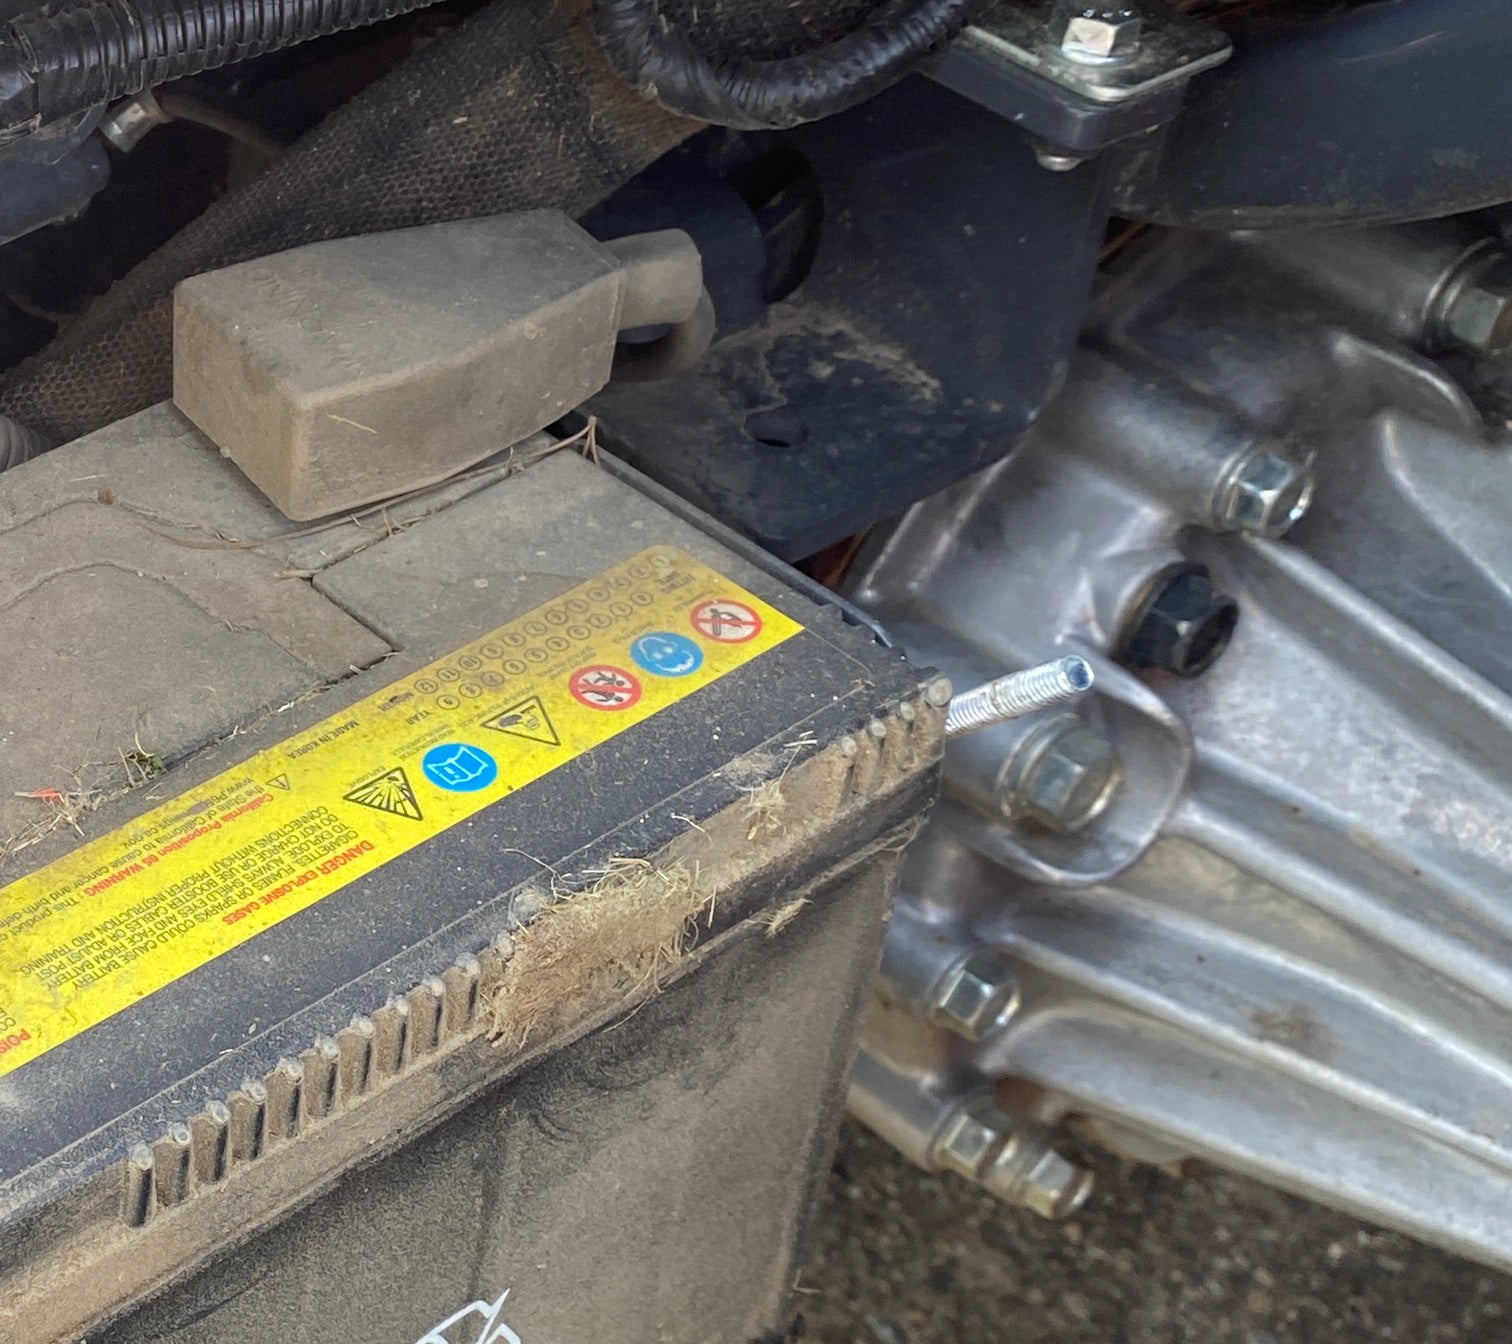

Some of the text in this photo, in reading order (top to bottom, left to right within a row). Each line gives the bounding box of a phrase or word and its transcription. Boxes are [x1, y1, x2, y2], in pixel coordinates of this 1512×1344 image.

[404, 708, 432, 725] YEAR
[286, 719, 359, 760] MADE IN KOREA
[214, 793, 247, 813] State
[242, 784, 265, 798] the
[202, 808, 219, 819] of
[219, 791, 275, 824] California
[153, 815, 207, 846] California
[154, 818, 223, 858] Proposition
[253, 804, 329, 849] CONNECTIONS
[329, 821, 349, 834] TO
[109, 847, 143, 868] cause
[141, 841, 157, 852] to
[206, 843, 257, 874] WITHOUT
[140, 853, 160, 867] 65
[241, 855, 286, 882] ALWAYS
[69, 864, 110, 888] cancer
[82, 861, 144, 897] WARNING
[163, 868, 211, 897] PROPER
[220, 839, 374, 925] DANGER EXPLOSIVE GASES
[250, 863, 296, 891] FLAMES
[34, 812, 339, 981] DO NOT CHARGE OR USE BOOSTER CABLES OR ADJUST POST
[48, 885, 73, 901] and
[204, 877, 245, 903] SHIELD
[233, 885, 255, 900] OR
[22, 897, 51, 915] birth
[51, 894, 79, 913] This
[94, 891, 168, 935] INSTRUCTION
[175, 898, 208, 918] EYES
[192, 895, 238, 923] SPARKS
[5, 906, 54, 936] product
[152, 913, 180, 931] AND
[154, 917, 197, 944] COULD
[69, 929, 98, 948] AND
[124, 926, 156, 946] FACE
[91, 941, 128, 964] FROM
[117, 938, 158, 964] CAUSE
[69, 959, 121, 990] BATTERY
